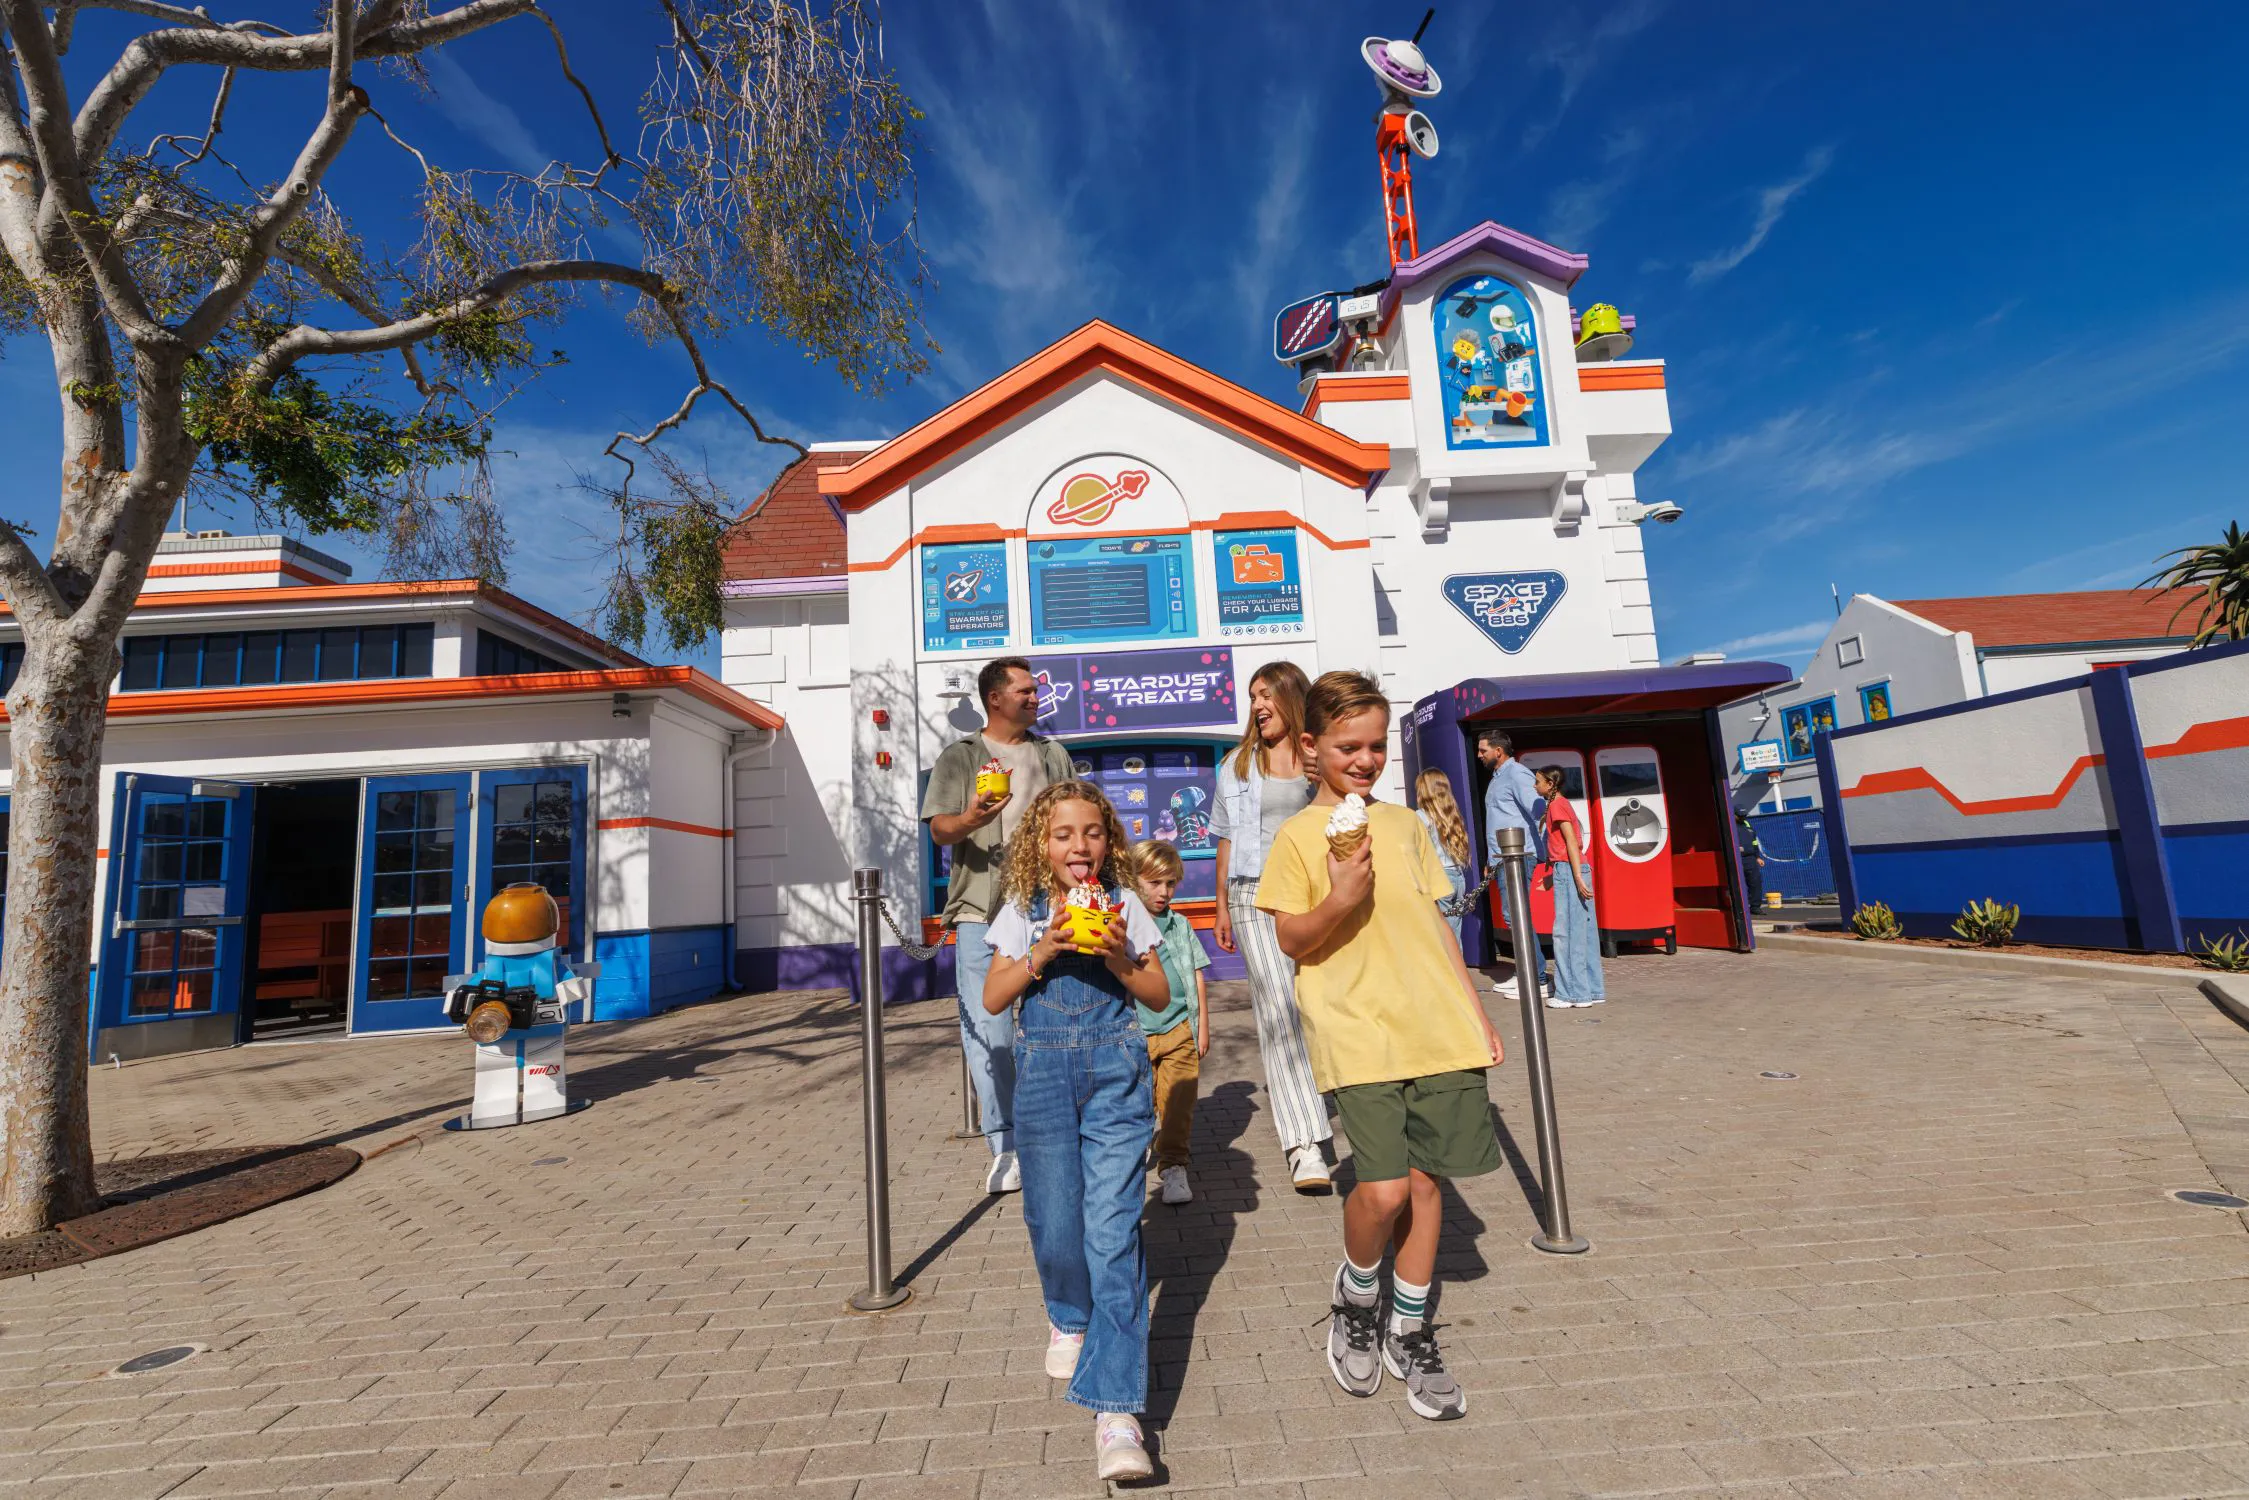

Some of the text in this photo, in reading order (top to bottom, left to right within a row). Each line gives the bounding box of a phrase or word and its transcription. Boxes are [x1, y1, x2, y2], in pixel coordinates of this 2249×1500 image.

[1466, 584, 1546, 600] SPACE
[1223, 603, 1299, 615] FOR ALIENS
[949, 615, 990, 623] SWARMS
[1490, 614, 1528, 625] 886
[949, 622, 1005, 630] SEPERATORS
[1093, 672, 1222, 692] STARDUST
[1111, 688, 1206, 706] TREATS
